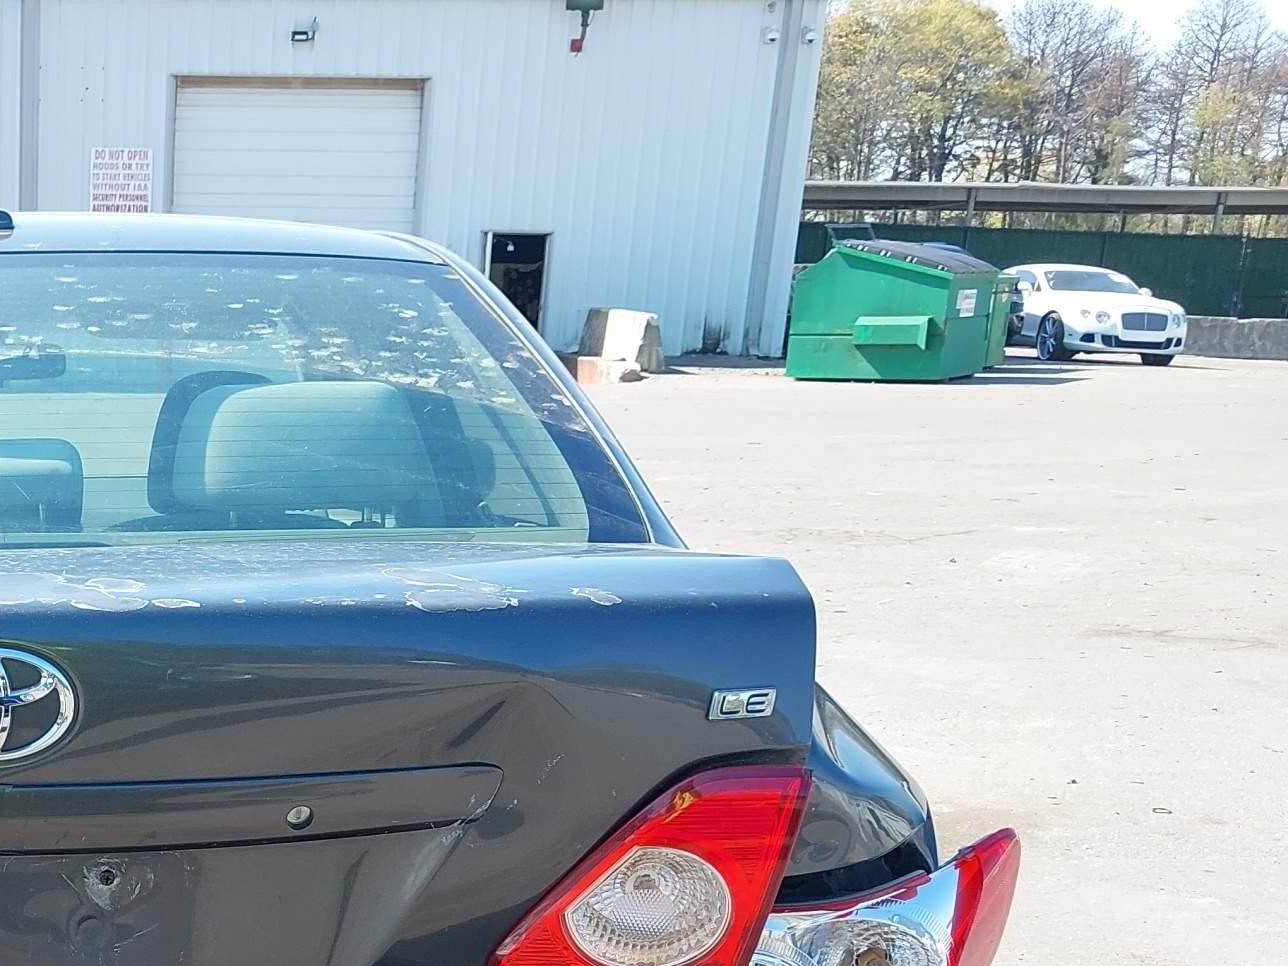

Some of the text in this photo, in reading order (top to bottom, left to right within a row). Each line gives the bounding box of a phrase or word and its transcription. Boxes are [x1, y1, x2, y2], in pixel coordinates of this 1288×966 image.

[94, 149, 149, 161] DO NOT OPEN
[92, 162, 150, 171] HOODS OR TRY
[92, 172, 150, 182] TO START VEHICLES
[92, 182, 149, 192] WITHOUT IAA
[92, 193, 149, 203] SECURITY PERSONNEL
[92, 203, 149, 213] AUTHORIZATION
[718, 691, 770, 716] LE
